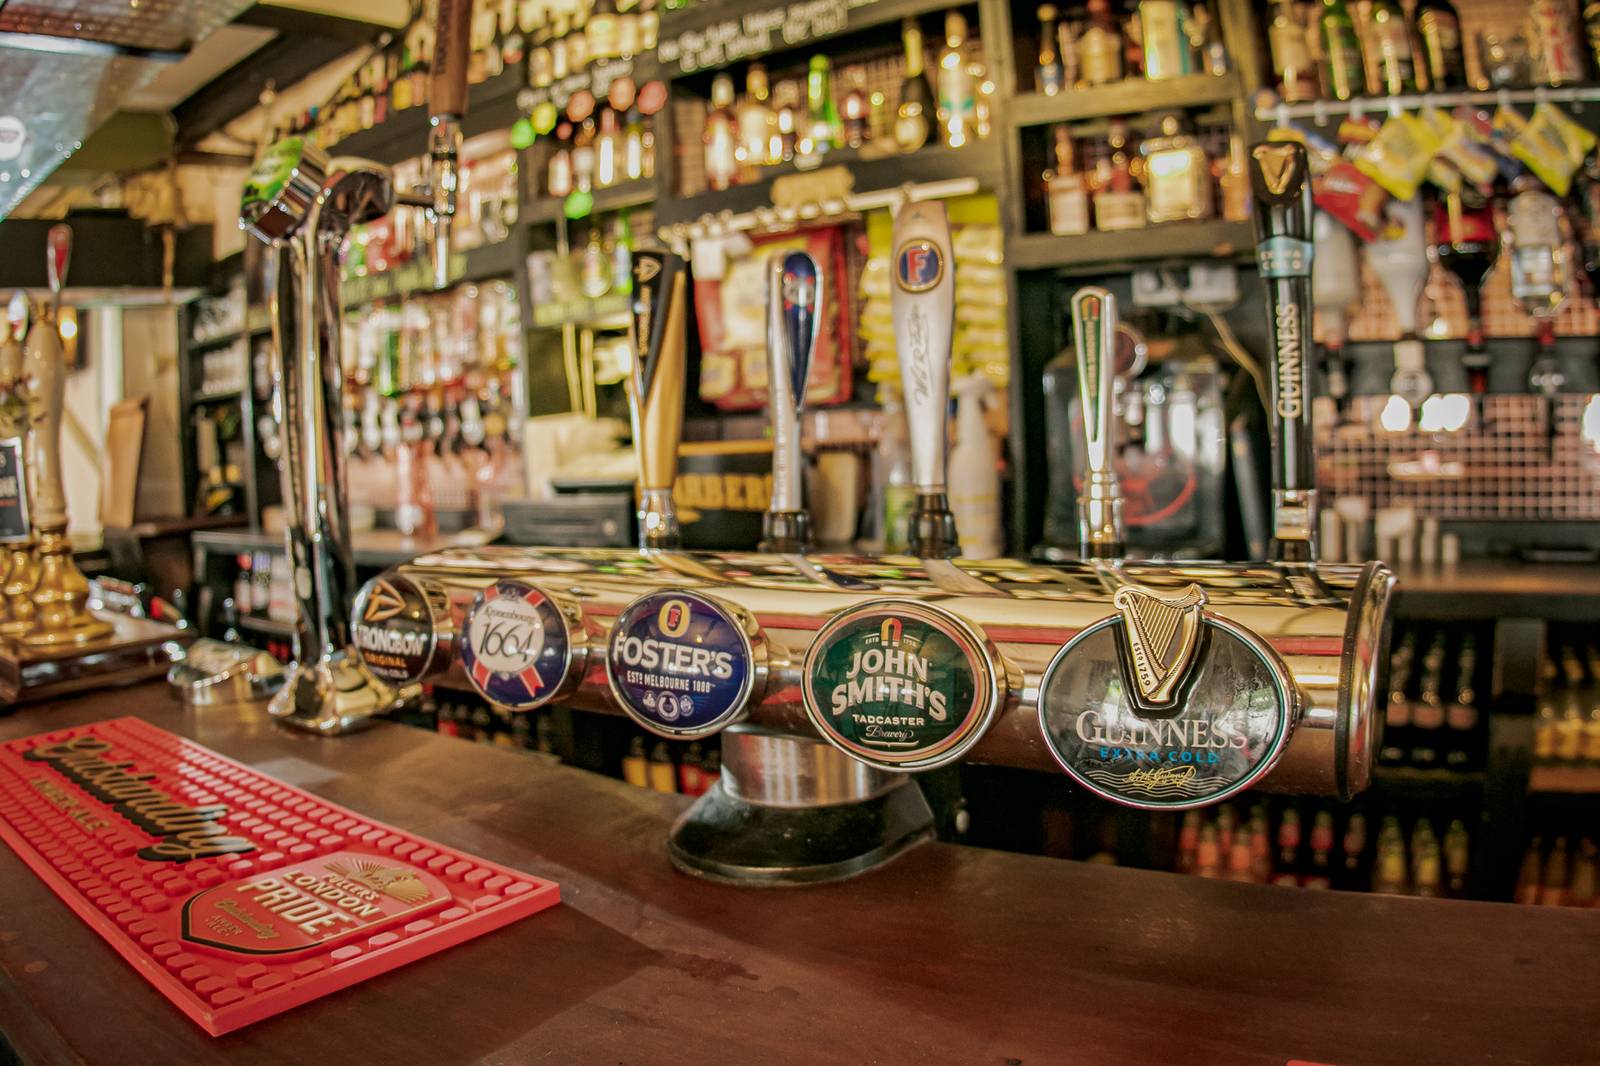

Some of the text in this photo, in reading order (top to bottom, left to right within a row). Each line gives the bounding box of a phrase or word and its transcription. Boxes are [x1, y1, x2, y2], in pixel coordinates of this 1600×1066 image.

[907, 249, 930, 284] F
[1276, 303, 1302, 419] GUINNESS
[479, 621, 537, 663] 1664
[612, 635, 733, 680] FOSTER'S
[644, 674, 690, 692] MELBOURNE
[846, 648, 929, 683] JOHN
[1137, 662, 1151, 686] 1759
[831, 676, 948, 722] SMITH'S
[852, 714, 925, 726] TADCASTER
[865, 725, 914, 742] Brewery
[1075, 710, 1248, 749] GUINNESS
[1099, 746, 1219, 765] EXTRA COLD
[24, 736, 257, 864] Outstanding
[282, 870, 381, 917] LONDON
[320, 873, 380, 901] FULLER'S
[235, 877, 350, 935] PRIDE
